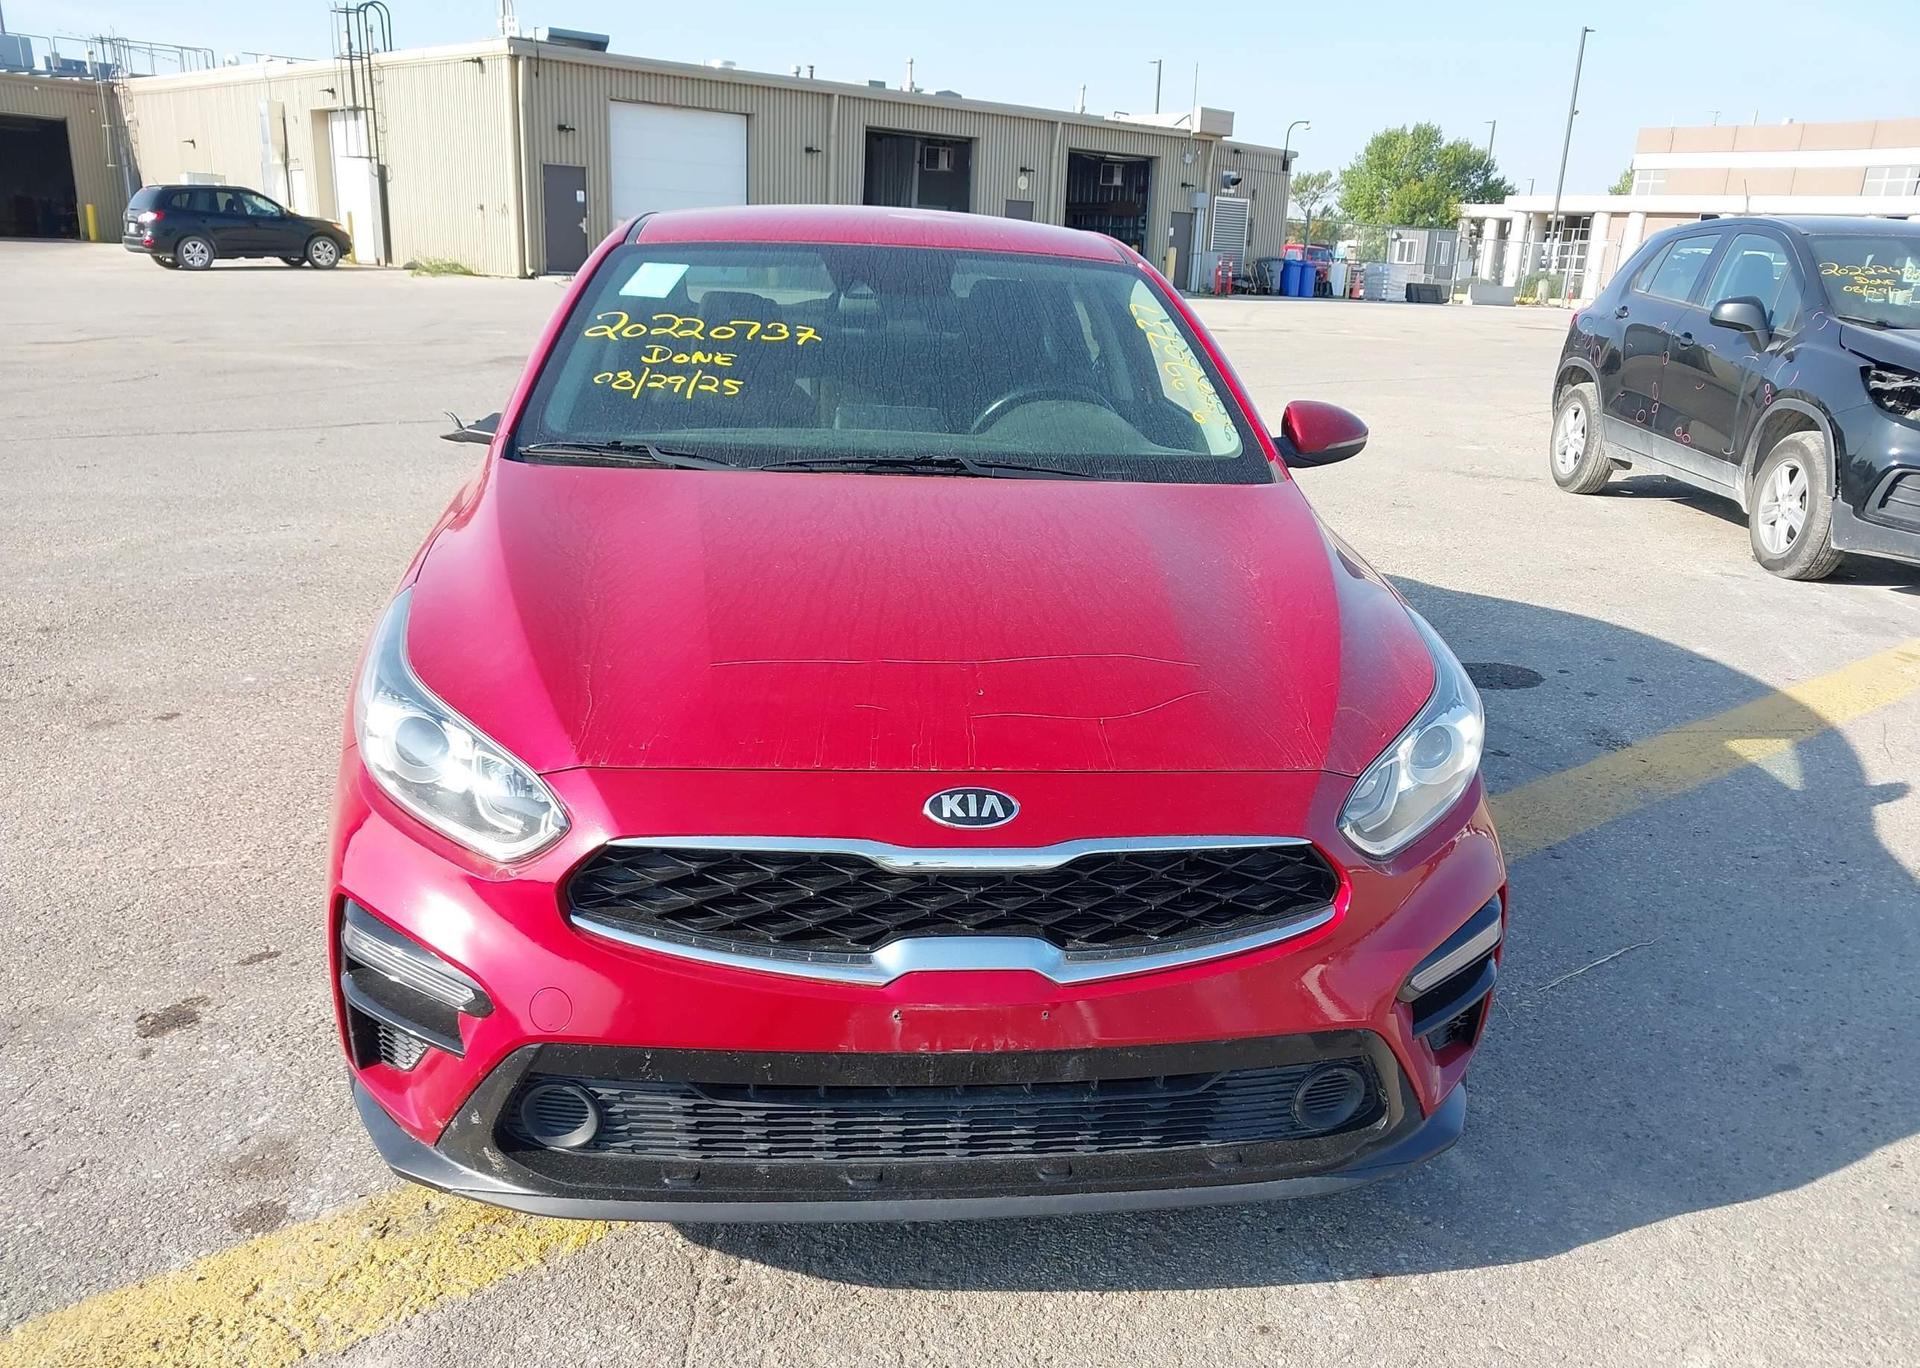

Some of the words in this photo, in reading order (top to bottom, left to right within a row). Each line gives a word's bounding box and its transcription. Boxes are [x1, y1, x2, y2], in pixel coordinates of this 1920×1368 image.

[584, 311, 823, 346] 20220737
[640, 345, 737, 366] DONE
[593, 367, 744, 399] 08/29/25
[940, 794, 1006, 818] KIA
